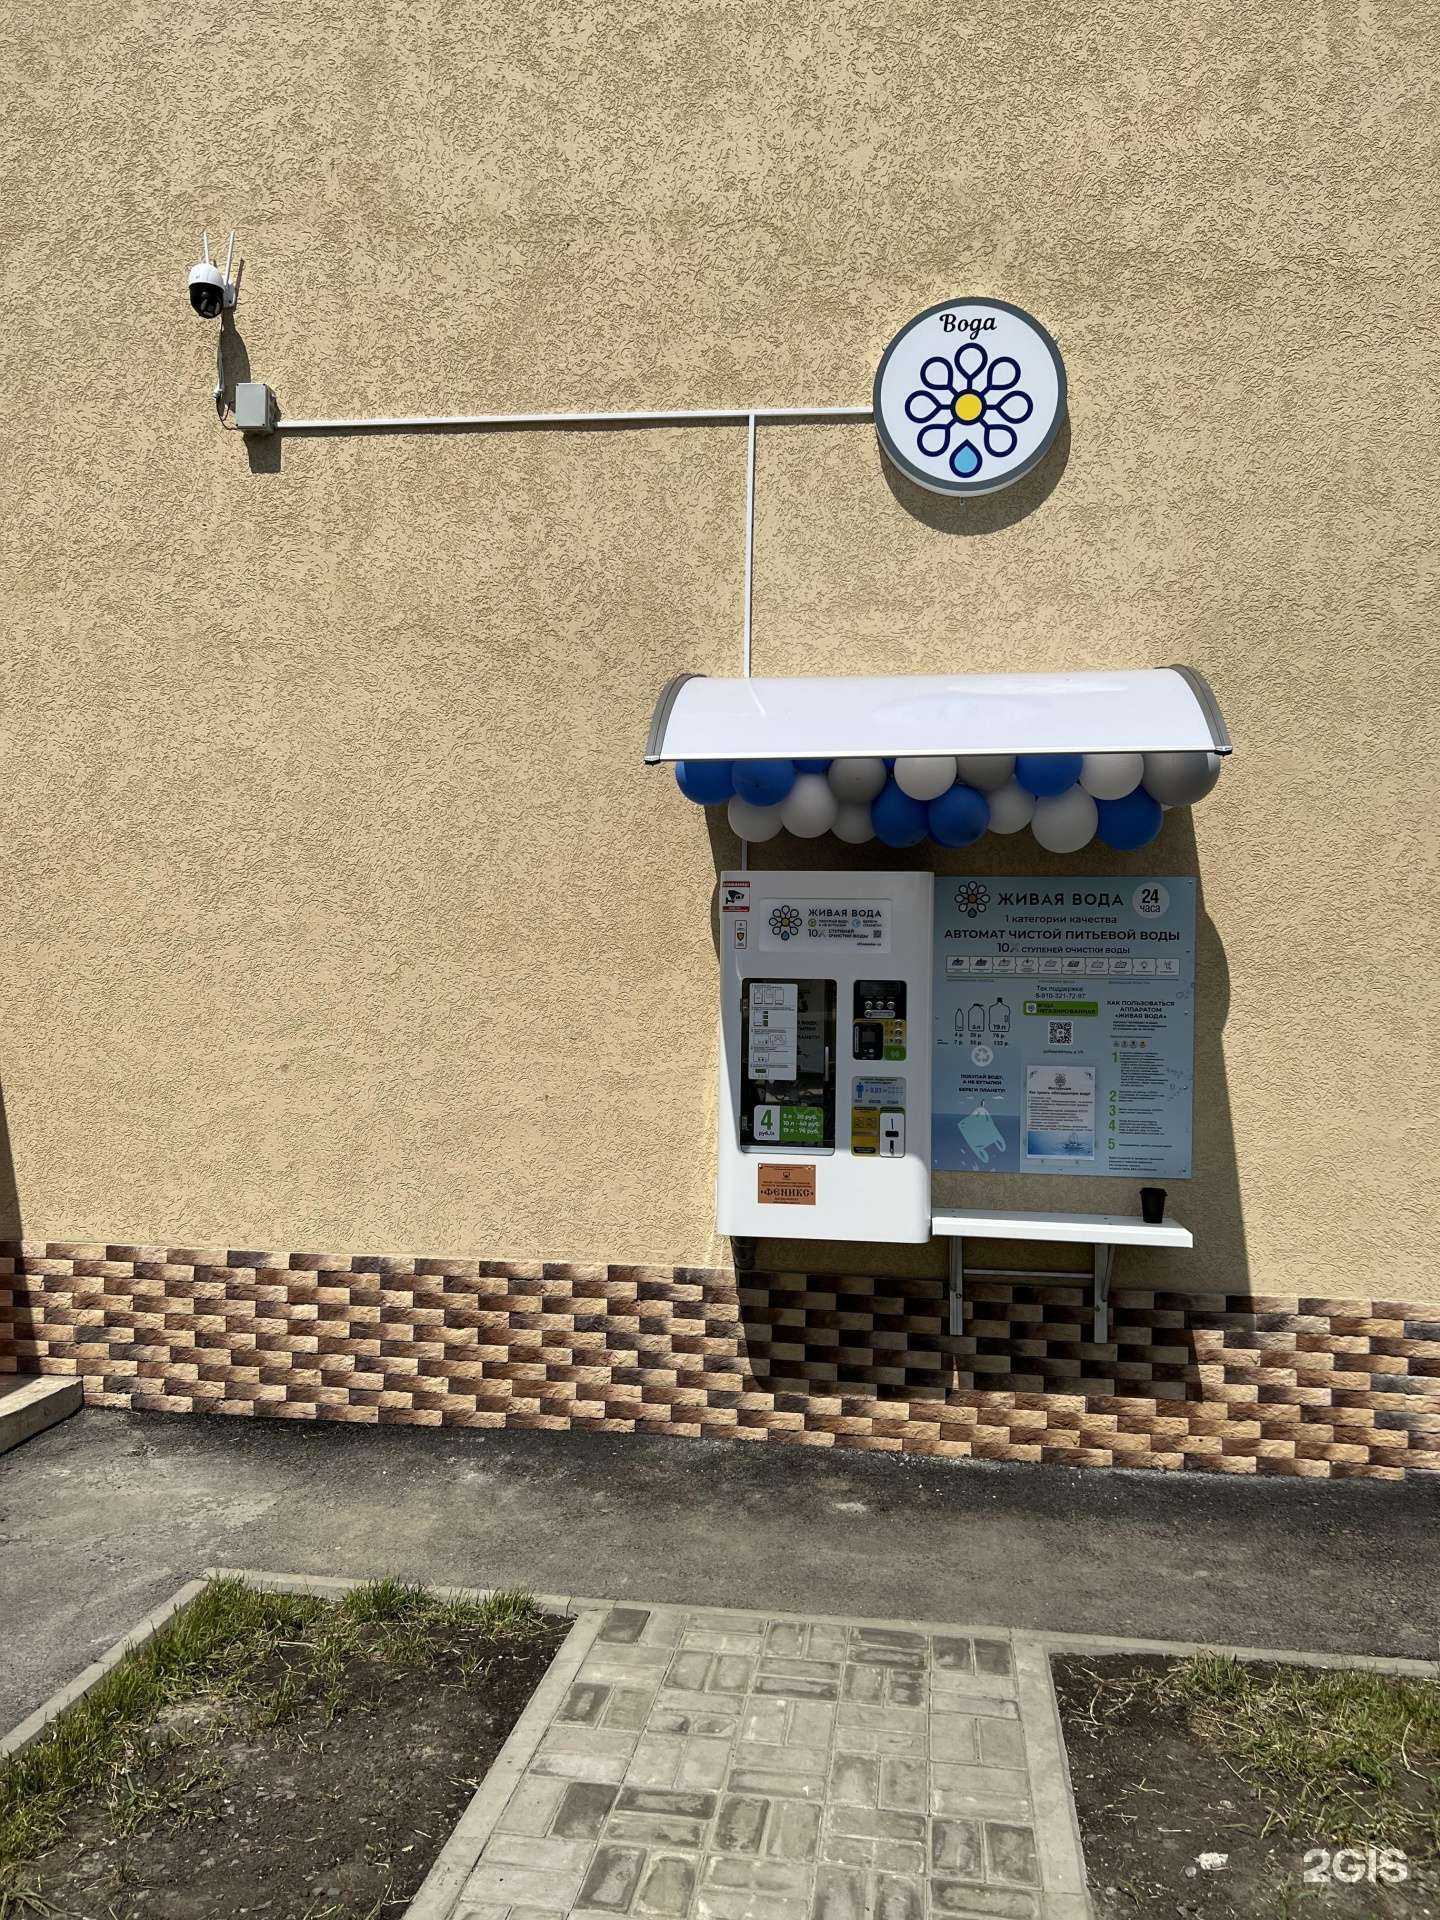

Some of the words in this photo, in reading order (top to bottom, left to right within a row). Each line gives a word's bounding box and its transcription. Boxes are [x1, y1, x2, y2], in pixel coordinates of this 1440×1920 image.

[939, 313, 998, 341] Вода
[997, 892, 1065, 906] ЖИВАЯ
[1072, 893, 1124, 908] ВОДА
[1141, 888, 1160, 904] 24
[808, 908, 848, 918] ЖИВАЯ
[851, 909, 882, 919] ВОДА
[1139, 904, 1161, 914] часа
[1005, 914, 1010, 923] 1
[1012, 915, 1067, 925] категории
[1070, 916, 1118, 924] качества
[807, 928, 819, 938] 10
[944, 929, 1006, 940] АВТОМАТ
[1008, 928, 1063, 940] ЧИСТОЙ
[1065, 928, 1136, 941] ПИТЬЕВОЙ
[1139, 930, 1180, 942] ВОДЫ
[997, 942, 1010, 953] 10
[1111, 1051, 1118, 1063] 1
[1109, 1090, 1117, 1102] 2
[1109, 1104, 1117, 1116] 3
[760, 1109, 774, 1131] 4
[1107, 1119, 1116, 1131] 4
[1107, 1137, 1116, 1150] 5
